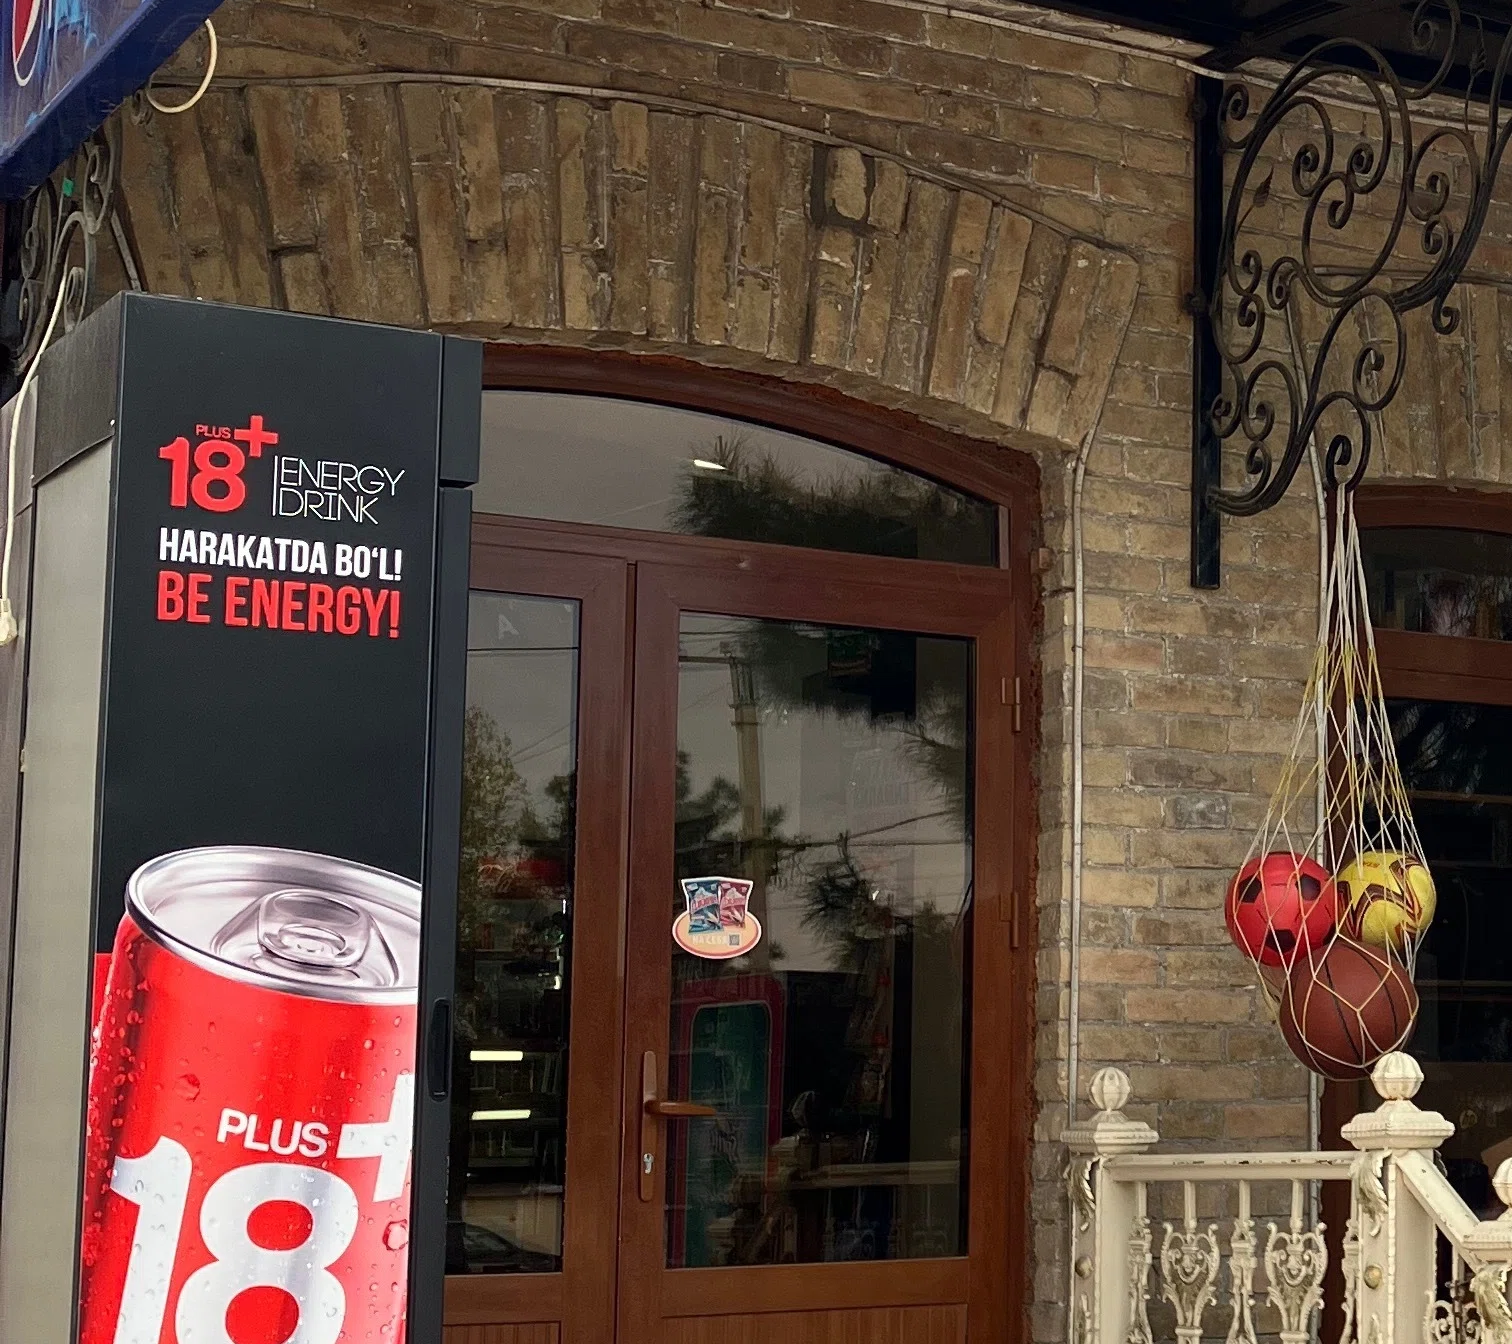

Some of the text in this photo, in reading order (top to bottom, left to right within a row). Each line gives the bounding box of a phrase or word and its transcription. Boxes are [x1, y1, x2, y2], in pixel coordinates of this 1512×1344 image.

[195, 424, 232, 440] PLUS
[279, 456, 405, 498] ENERGY
[278, 487, 379, 525] DRINK
[159, 526, 328, 576] HARAKATDA
[156, 569, 401, 639] BE ENERGY!
[216, 1107, 329, 1159] PLUS
